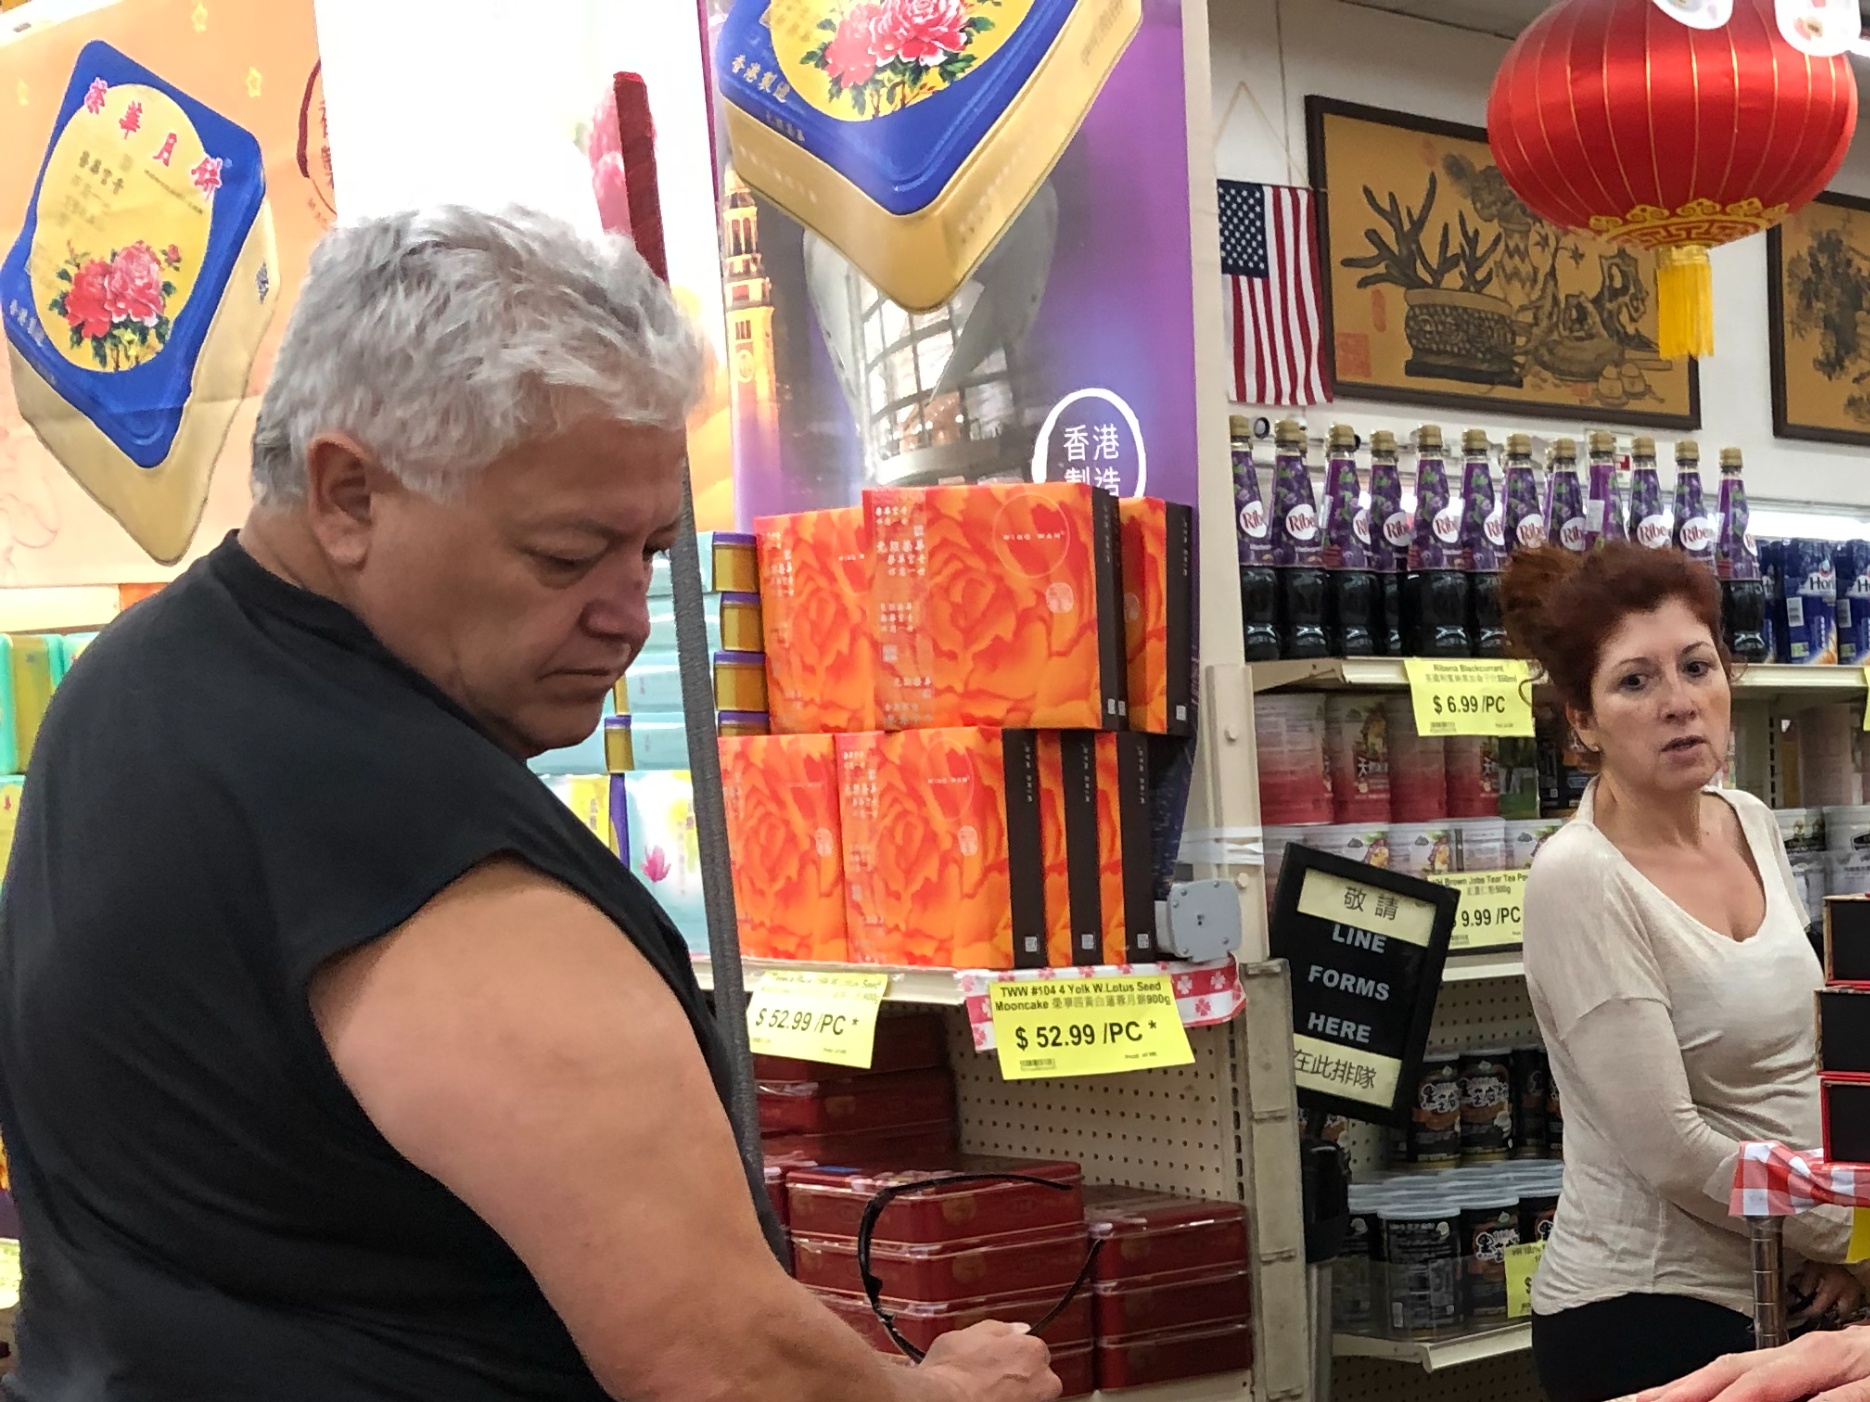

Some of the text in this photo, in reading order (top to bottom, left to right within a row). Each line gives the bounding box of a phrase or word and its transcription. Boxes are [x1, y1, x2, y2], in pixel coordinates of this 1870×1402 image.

[1063, 424, 1119, 460] 香港
[1433, 695, 1505, 715] $ 6.99 /PC
[1487, 875, 1501, 884] Tear
[1504, 874, 1516, 883] Tea
[1344, 886, 1398, 921] 敬請
[1461, 906, 1521, 927] 9.99 /PC
[1332, 923, 1387, 953] LINE
[1000, 986, 1028, 998] TWW
[1031, 985, 1056, 996] #104
[1058, 985, 1065, 994] 4
[1067, 984, 1090, 994] Yolk
[1137, 981, 1162, 992] Seed
[1308, 964, 1390, 1001] FORMS
[995, 1000, 1049, 1011] Mooncake
[755, 1007, 846, 1035] $ 52.99 /PC
[1015, 1020, 1143, 1051] $ 52.99 /PC
[1307, 1012, 1372, 1044] HERE
[1294, 1049, 1377, 1090] 在此排隊
